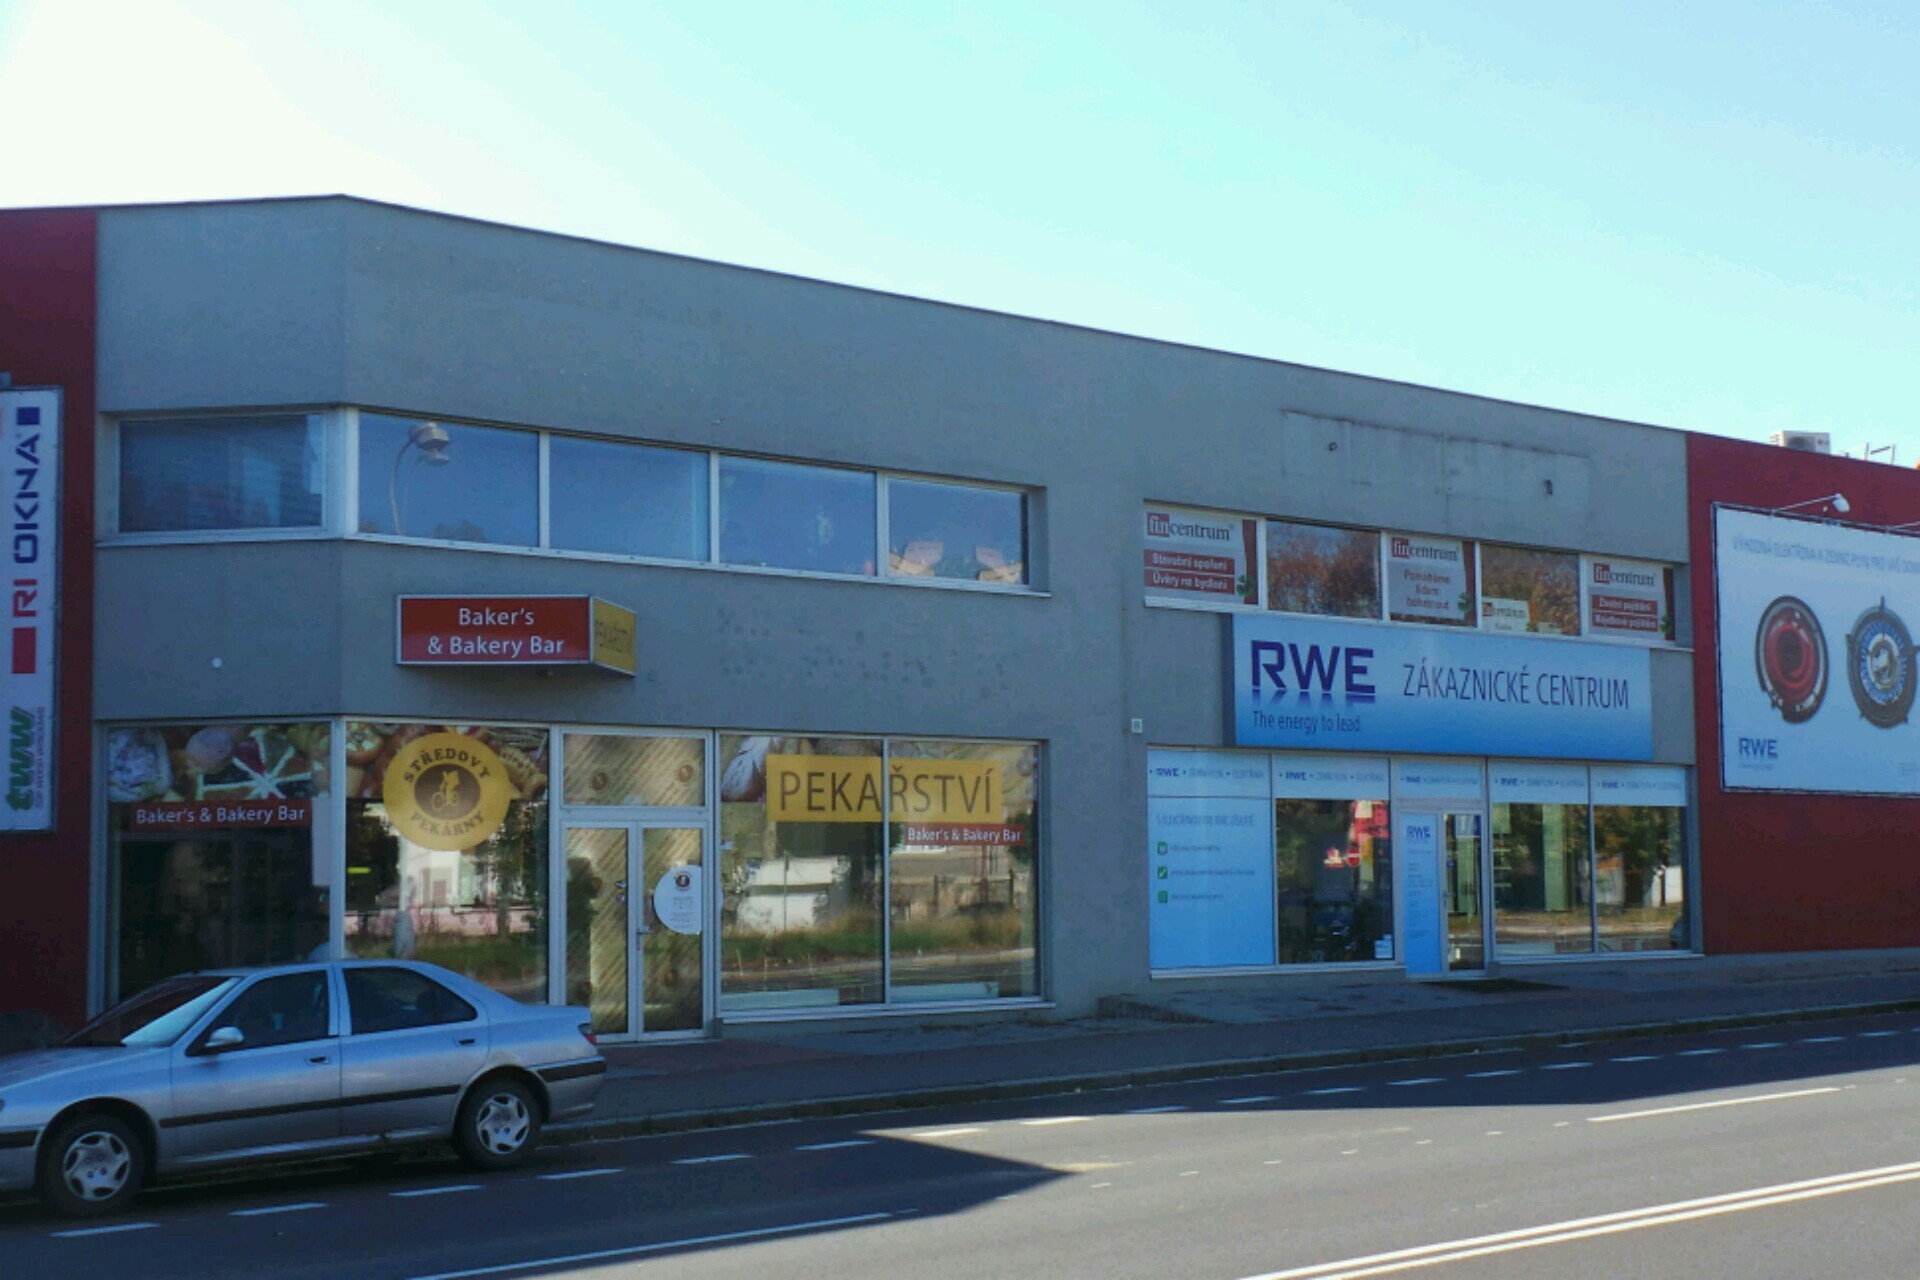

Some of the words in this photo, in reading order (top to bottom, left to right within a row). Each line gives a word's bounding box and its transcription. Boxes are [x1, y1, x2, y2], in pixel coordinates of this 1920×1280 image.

[14, 432, 41, 564] OKNA
[1147, 514, 1230, 541] fincentrum
[1392, 538, 1458, 561] fincentrum
[1594, 563, 1654, 586] fincentrum
[12, 579, 38, 618] RI
[458, 607, 534, 626] Baker's
[428, 636, 443, 655] &
[450, 636, 522, 659] Bakery
[530, 635, 565, 655] Bar
[1251, 640, 1376, 695] RWE
[1403, 657, 1530, 705] ZÁKAZNICKÉ
[1536, 673, 1629, 709] CENTRUM
[1253, 711, 1275, 729] The
[1278, 715, 1319, 736] energy
[1320, 715, 1334, 732] to
[1336, 713, 1360, 732] lead
[1738, 737, 1779, 759] RWE
[779, 764, 994, 815] PEKAŘSTVÍ
[136, 808, 195, 824] Baker's
[199, 807, 212, 823] &
[217, 807, 273, 824] Bakery
[277, 805, 305, 821] Bar
[908, 827, 949, 841] Baker's
[951, 827, 960, 841] &
[963, 827, 1000, 844] Bakery
[1003, 829, 1021, 842] Bar
[1406, 825, 1431, 839] RWE
